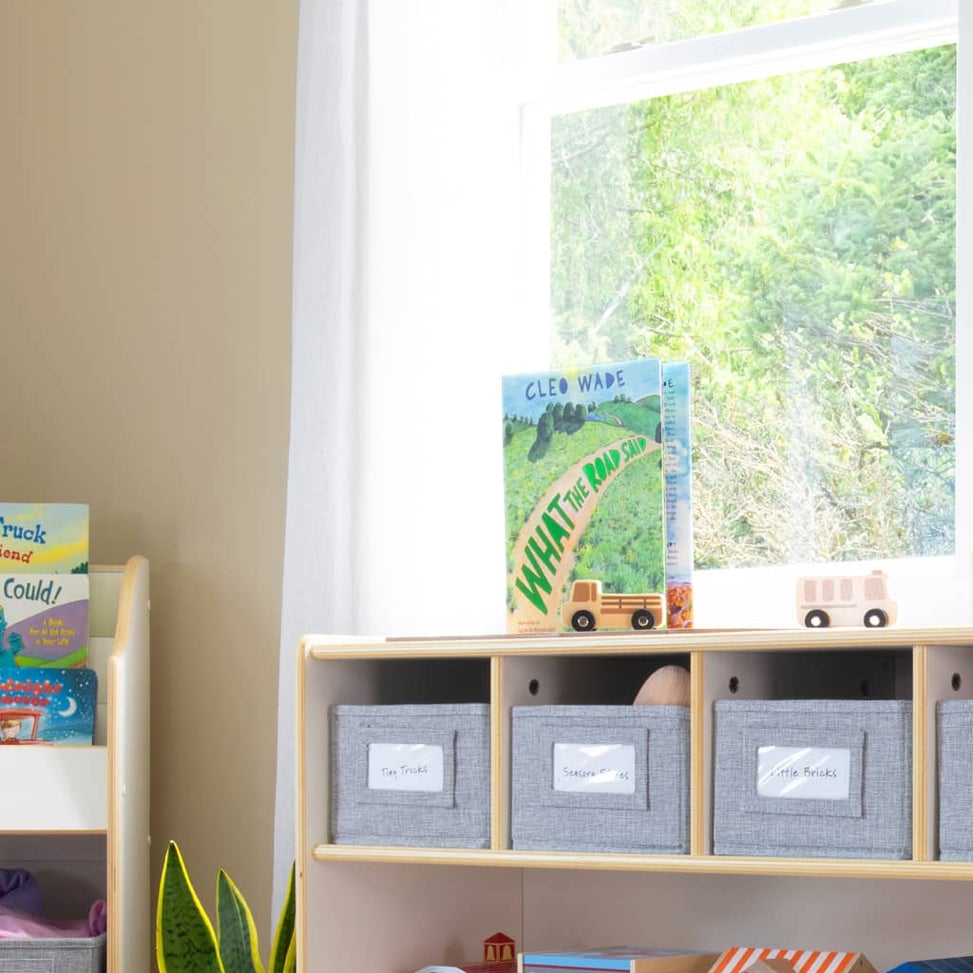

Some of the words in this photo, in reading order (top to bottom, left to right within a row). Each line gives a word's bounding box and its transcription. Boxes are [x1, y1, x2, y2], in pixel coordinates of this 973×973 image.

[525, 378, 568, 401] CLEO
[578, 370, 626, 393] WADE
[515, 493, 576, 616] WHAT
[563, 476, 591, 513] THE
[582, 449, 621, 494] ROAD
[620, 436, 647, 463] SAID
[0, 543, 33, 564] iend
[3, 577, 62, 605] Could!
[803, 766, 837, 778] Bricks
